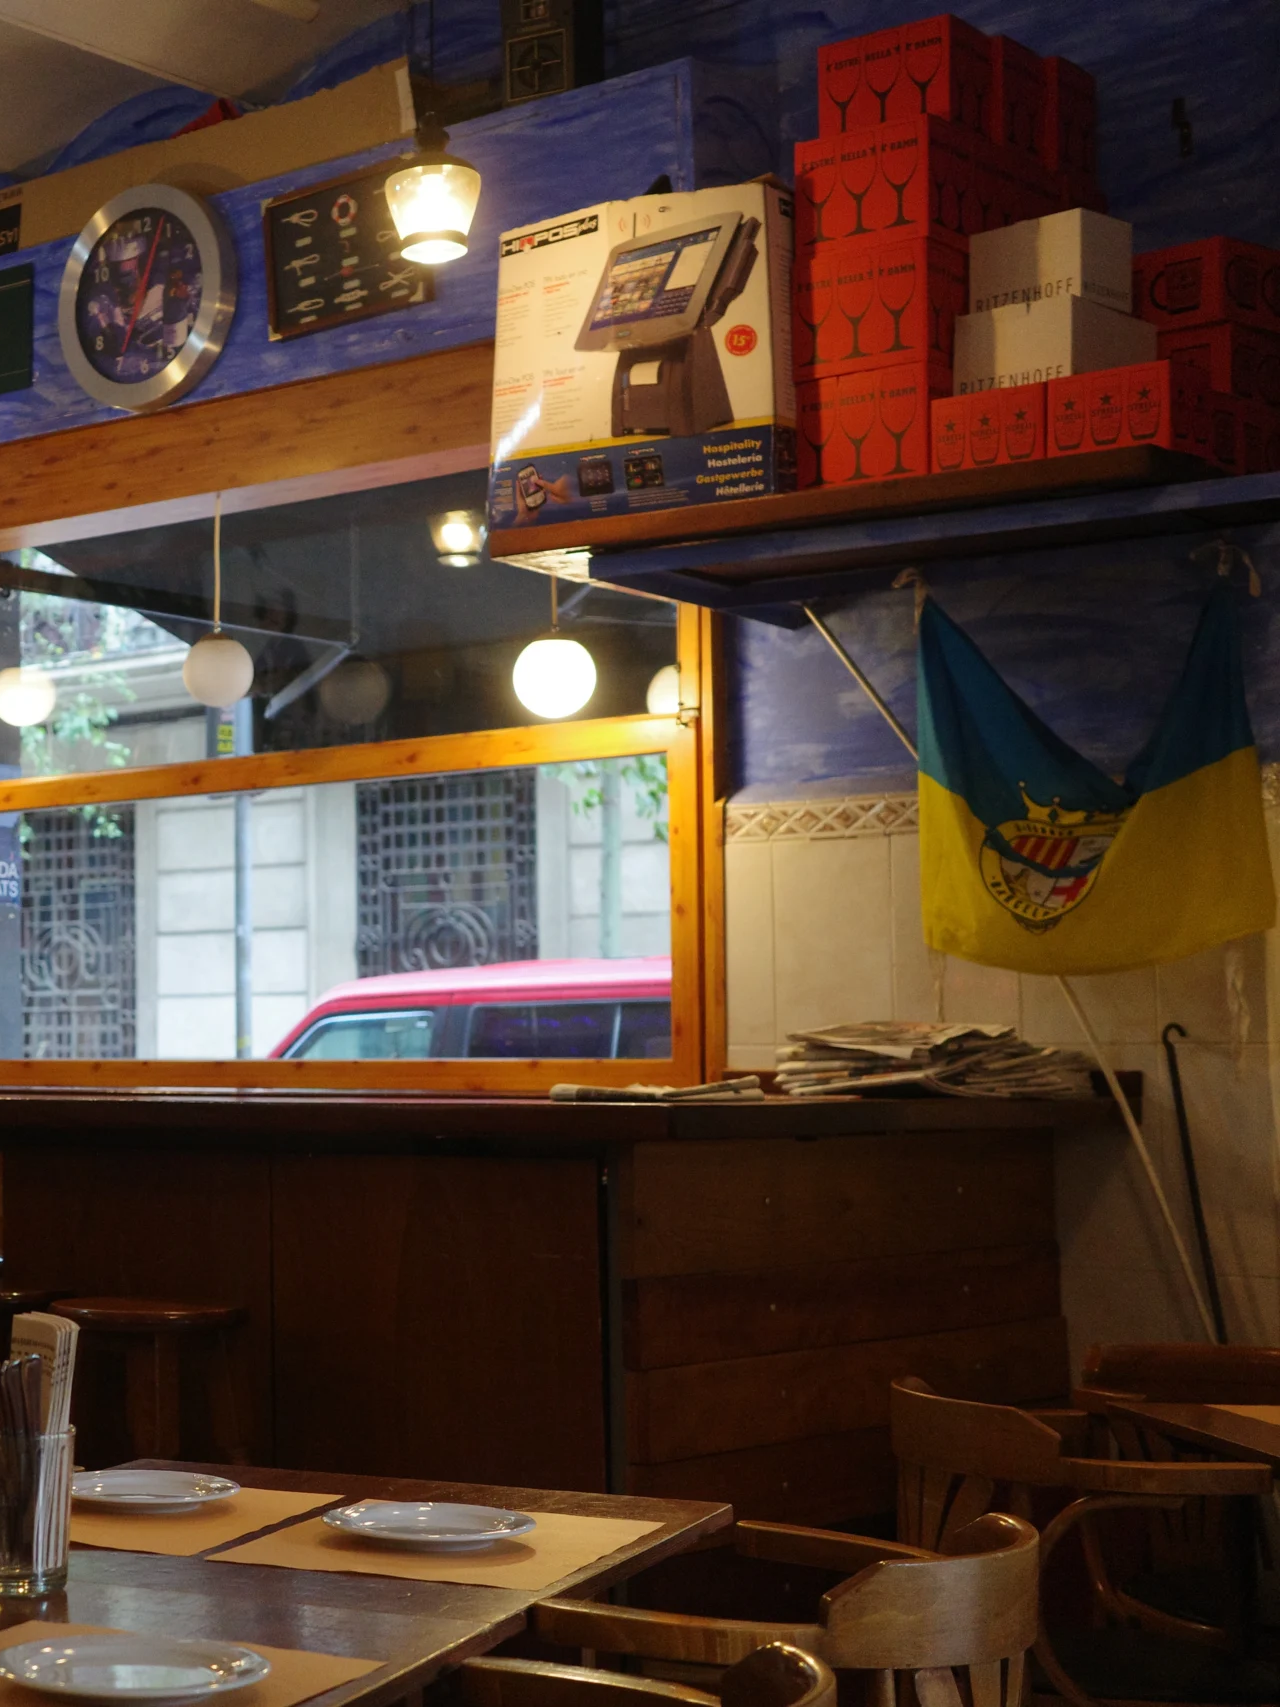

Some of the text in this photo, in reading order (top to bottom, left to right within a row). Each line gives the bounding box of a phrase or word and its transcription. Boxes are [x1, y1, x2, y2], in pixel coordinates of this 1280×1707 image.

[94, 269, 109, 284] 10
[976, 277, 1073, 313] RITZENHOFF
[96, 335, 104, 351] 8
[702, 438, 763, 455] Hospitality
[707, 453, 763, 469] Hosteleria
[696, 467, 765, 485] Gastgewerbe
[715, 481, 765, 497] Hôtellerie
